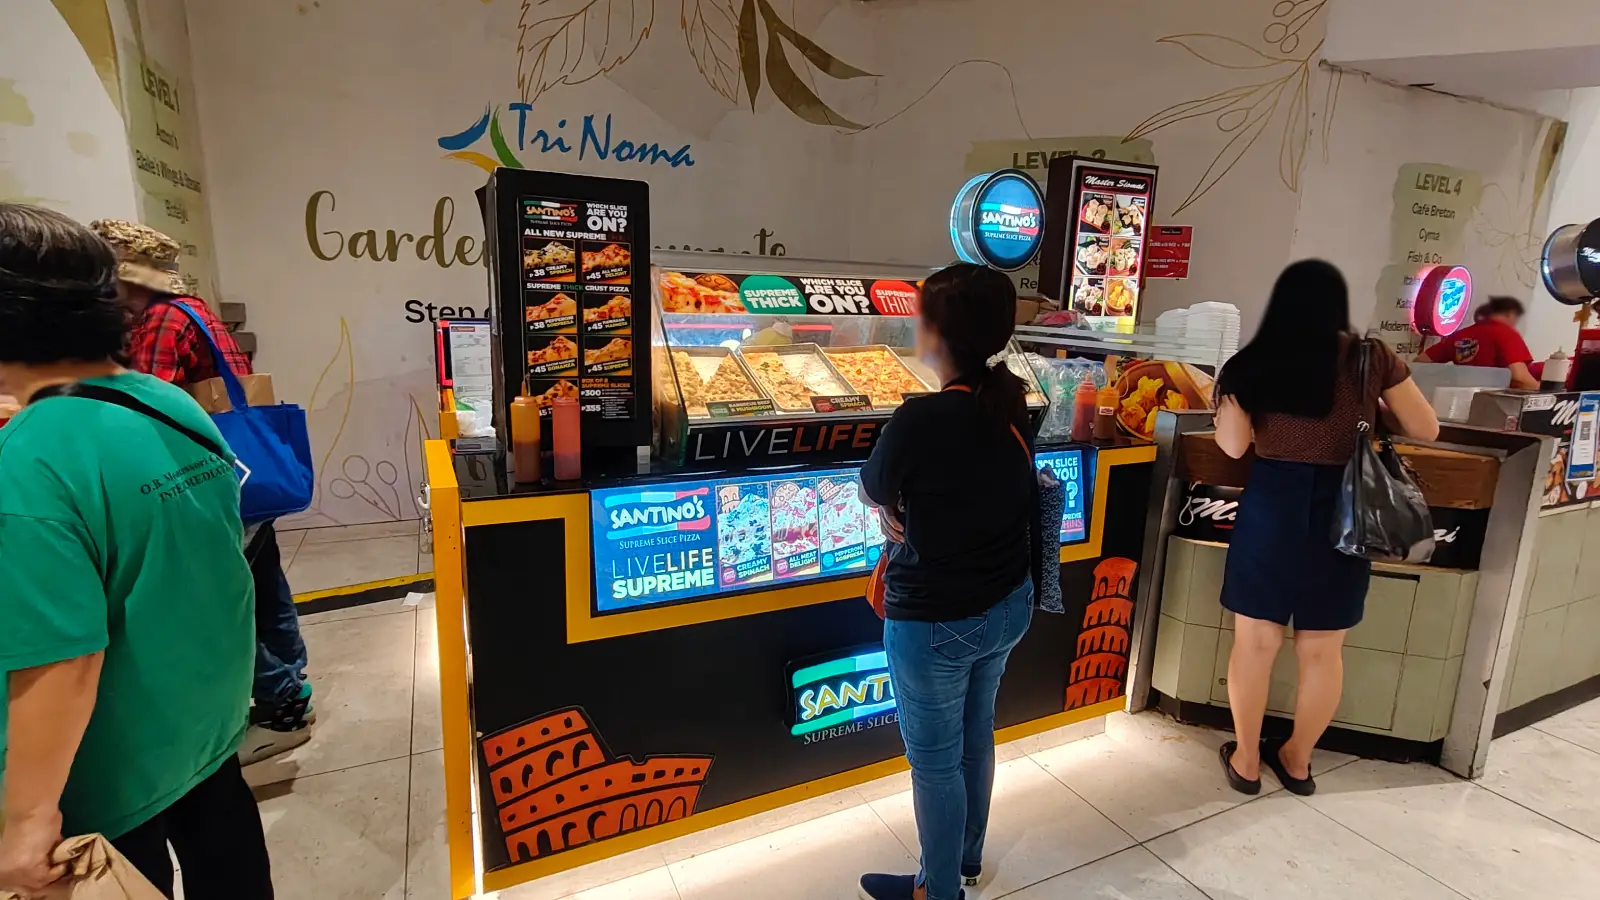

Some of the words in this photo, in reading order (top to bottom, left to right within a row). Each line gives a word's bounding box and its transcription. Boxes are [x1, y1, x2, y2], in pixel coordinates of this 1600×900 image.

[1012, 149, 1078, 169] LEV
[1084, 175, 1115, 187] Master
[1415, 172, 1451, 195] LEVEL
[1453, 178, 1463, 196] 4
[526, 206, 575, 217] SANTINO'S
[587, 208, 607, 216] ARE
[607, 209, 628, 218] YOU
[586, 216, 627, 233] ON?
[982, 211, 1036, 228] SANTINO'S
[524, 228, 542, 236] ALL
[543, 229, 565, 238] NEW
[566, 231, 607, 240] SUPREME
[800, 278, 835, 286] WHICH
[835, 279, 862, 287] SLICE
[743, 288, 799, 298] SUPREME
[804, 286, 833, 294] ARE
[834, 287, 866, 296] YOU
[745, 296, 804, 309] THICK
[809, 294, 870, 314] ON?
[1055, 457, 1078, 468] SLICE
[1053, 467, 1078, 481] YOU
[610, 495, 705, 529] SANTINO'S
[619, 538, 655, 550] SUPREME
[656, 536, 677, 545] SLICE
[679, 533, 702, 543] PIZZA
[789, 555, 800, 564] ALL
[800, 550, 817, 561] MEAT
[790, 556, 817, 568] DELIGHT
[736, 557, 769, 572] CREAMY
[738, 563, 770, 578] SPINACH
[612, 567, 715, 599] SUPREME
[803, 721, 864, 745] SUPREME
[867, 713, 900, 729] SLICE
